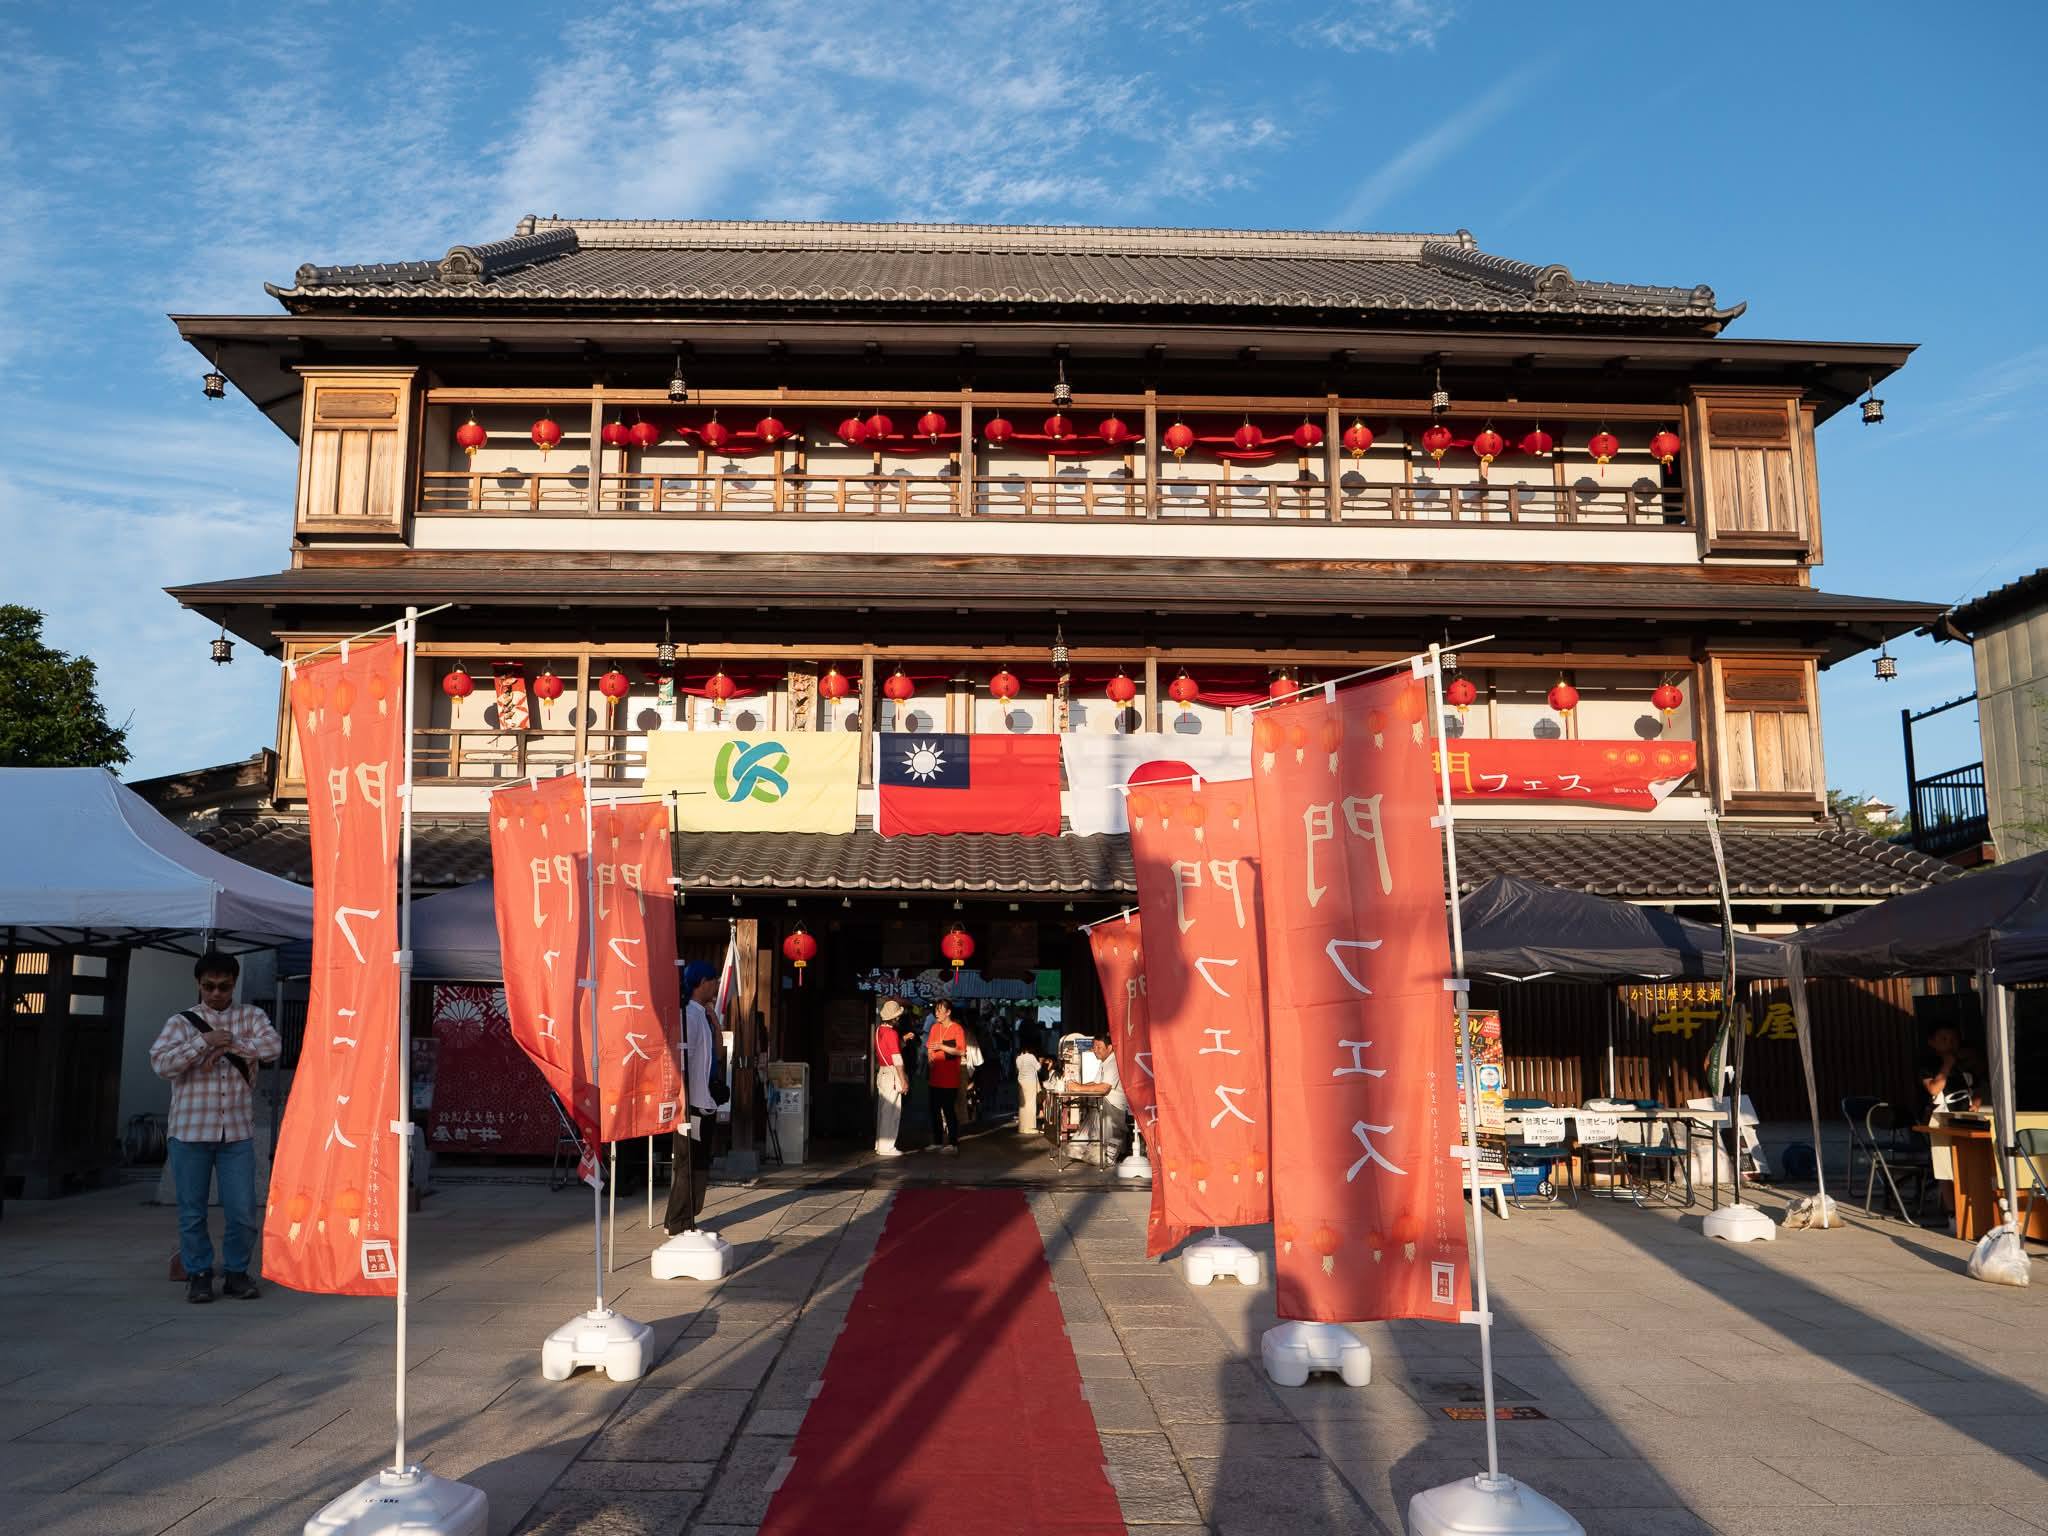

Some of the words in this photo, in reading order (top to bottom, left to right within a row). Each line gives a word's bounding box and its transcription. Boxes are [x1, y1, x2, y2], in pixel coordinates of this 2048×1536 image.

[1631, 986, 1735, 1002] かさま歴史交流
[1525, 1117, 1564, 1126] 台湾ビール
[1577, 1117, 1615, 1126] 台湾ビール
